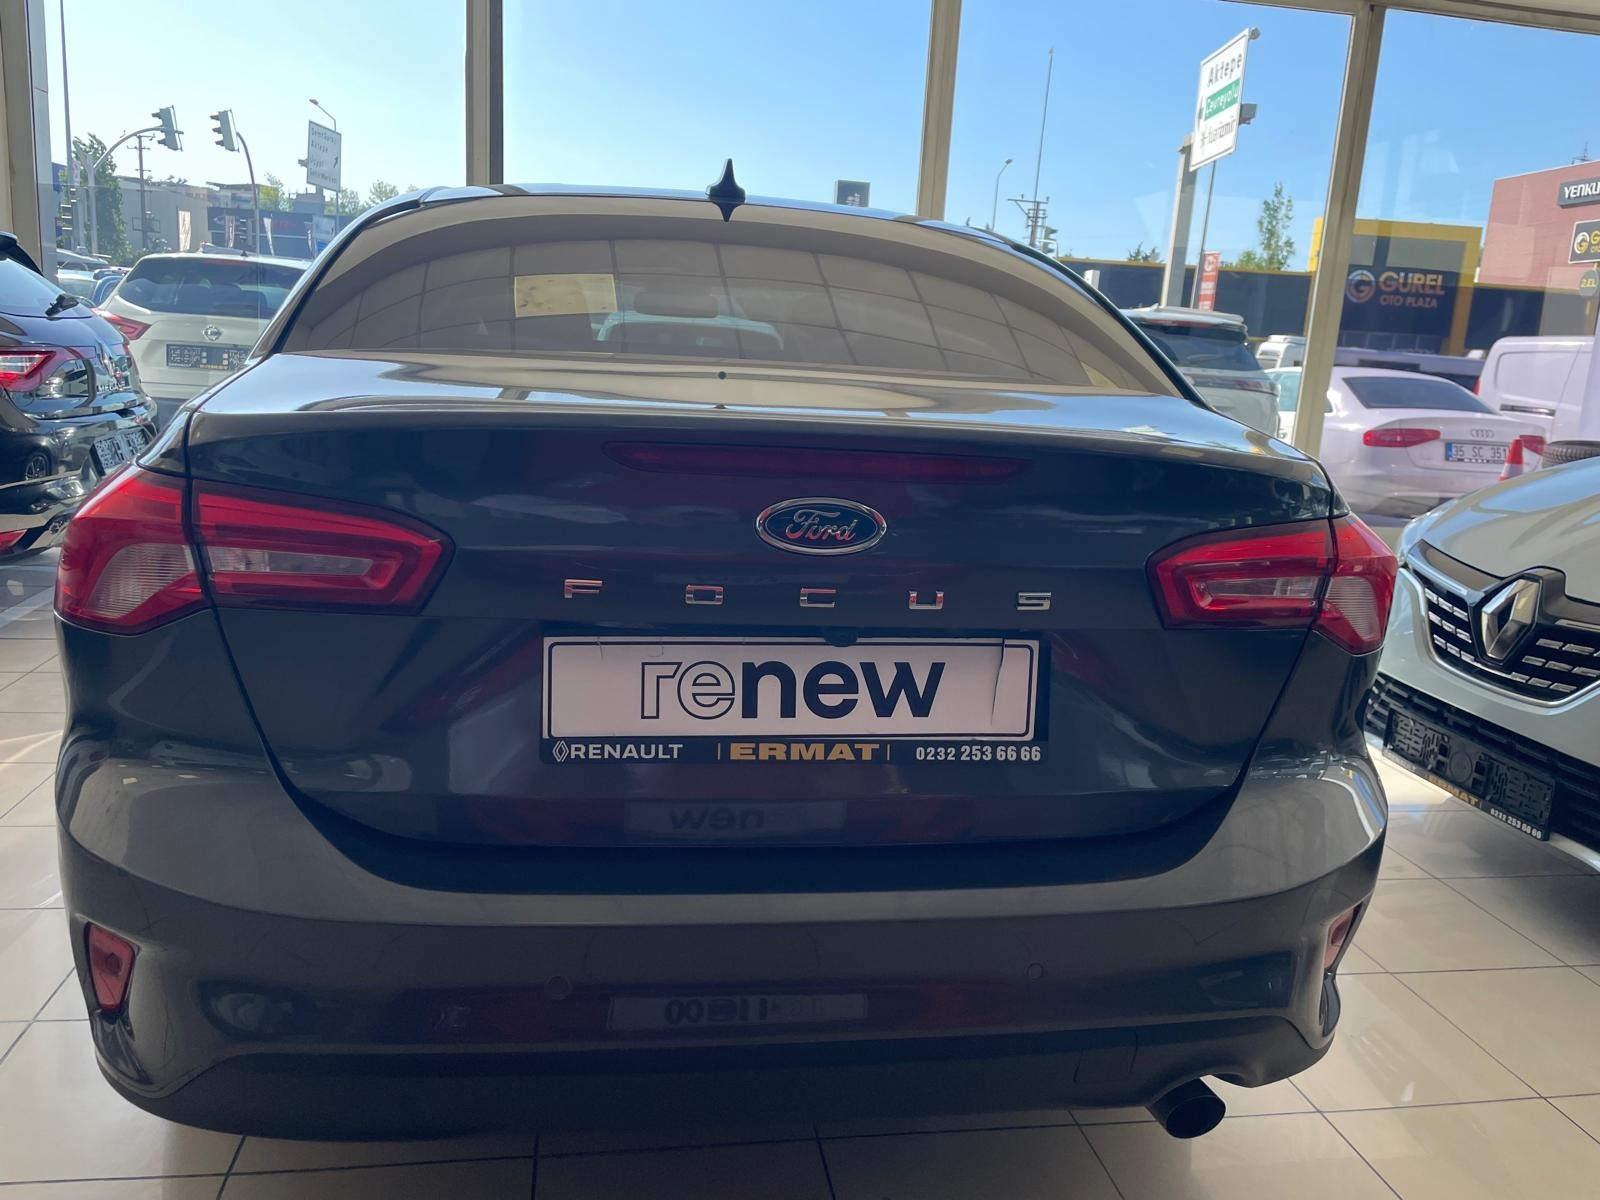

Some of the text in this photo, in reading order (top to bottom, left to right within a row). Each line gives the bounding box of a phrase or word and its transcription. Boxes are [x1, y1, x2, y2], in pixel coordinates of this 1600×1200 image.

[1207, 53, 1243, 88] Aktepe
[1380, 294, 1438, 308] OTO PLAZA
[1454, 445, 1465, 458] 35
[785, 508, 859, 541] Ford
[563, 578, 1053, 611] FOCUS
[640, 660, 946, 720] renew
[570, 742, 1042, 761] RENAULT ERMAT 0232 253 66 66
